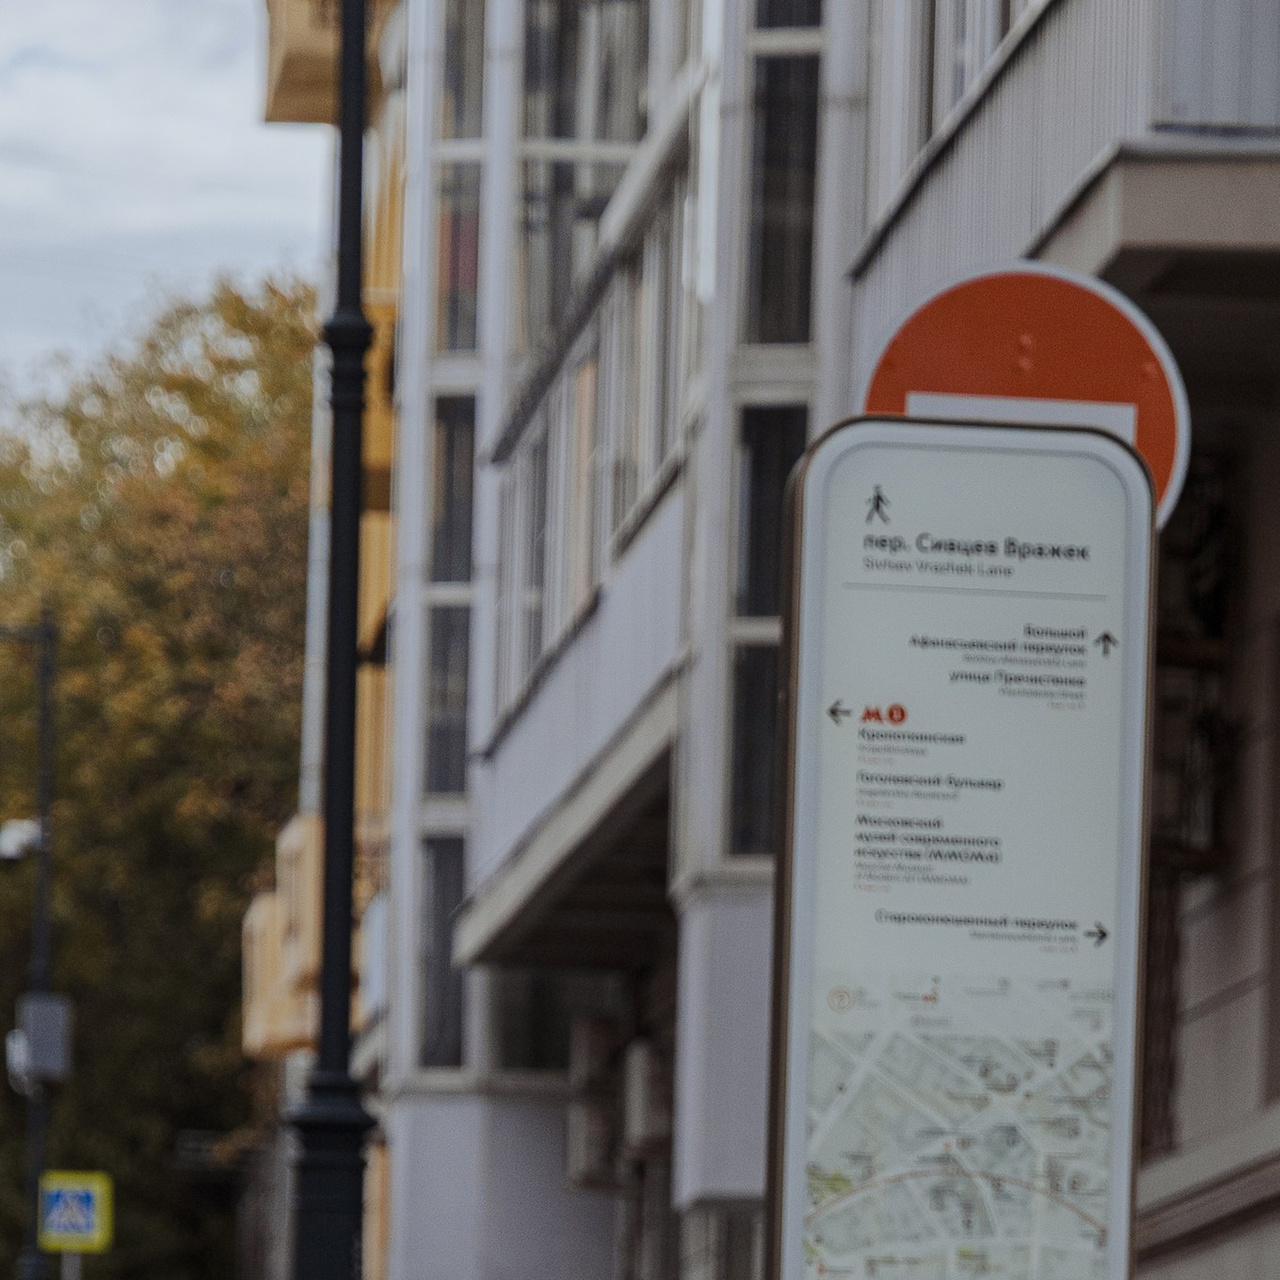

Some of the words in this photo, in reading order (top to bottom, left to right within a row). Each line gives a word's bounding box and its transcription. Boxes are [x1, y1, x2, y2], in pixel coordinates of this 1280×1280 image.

[863, 532, 908, 556] пер.
[916, 531, 998, 561] Сивцев
[1003, 536, 1090, 561] Вражек
